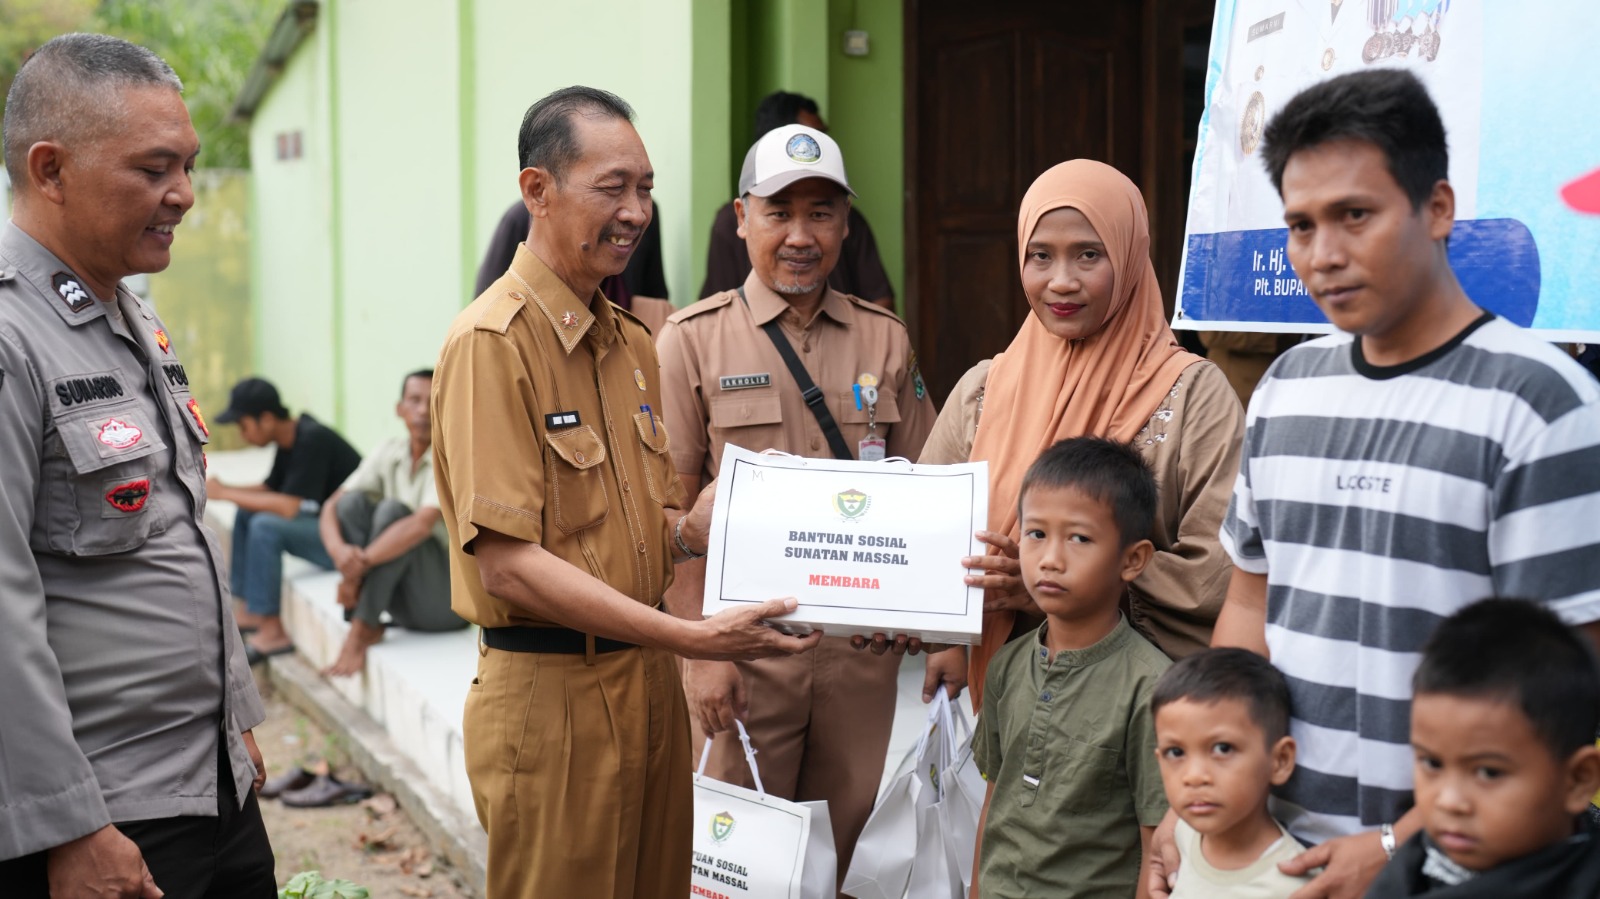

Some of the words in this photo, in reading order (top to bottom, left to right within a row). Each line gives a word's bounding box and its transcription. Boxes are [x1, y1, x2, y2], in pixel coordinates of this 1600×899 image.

[1252, 250, 1266, 272] Ir.
[1269, 247, 1287, 276] Hj.
[1254, 277, 1271, 296] Plt.
[788, 530, 853, 546] BANTUAN
[857, 534, 907, 550] SOSIAL
[784, 546, 849, 562] SUNATAN
[852, 550, 909, 566] MASSAL
[808, 574, 880, 590] MEMBARA
[716, 858, 748, 877] SOSIAL
[712, 871, 748, 891] MASSAL
